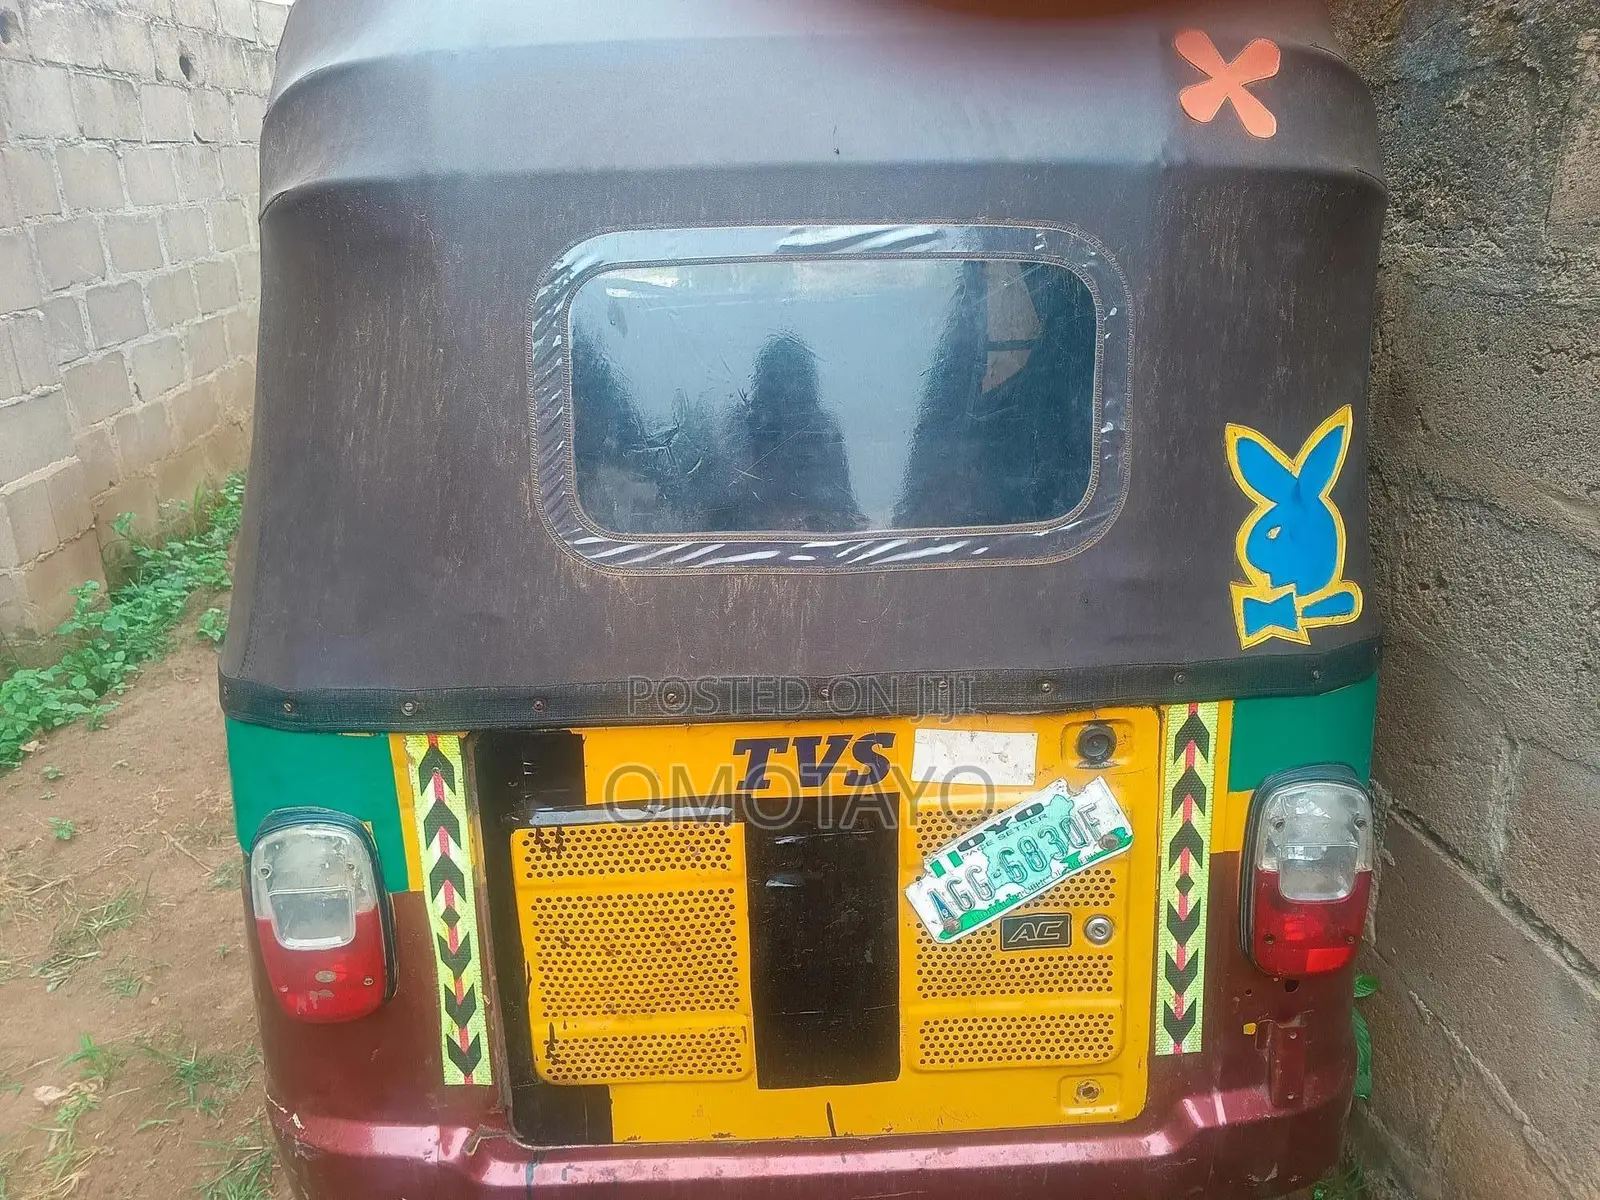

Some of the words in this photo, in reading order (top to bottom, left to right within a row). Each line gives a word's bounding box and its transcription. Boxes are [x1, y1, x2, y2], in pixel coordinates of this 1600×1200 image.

[732, 731, 897, 791] TVS
[957, 802, 1044, 852] OYO
[960, 839, 993, 859] PACE
[997, 811, 1047, 841] SETTER
[1007, 920, 1065, 944] AC
